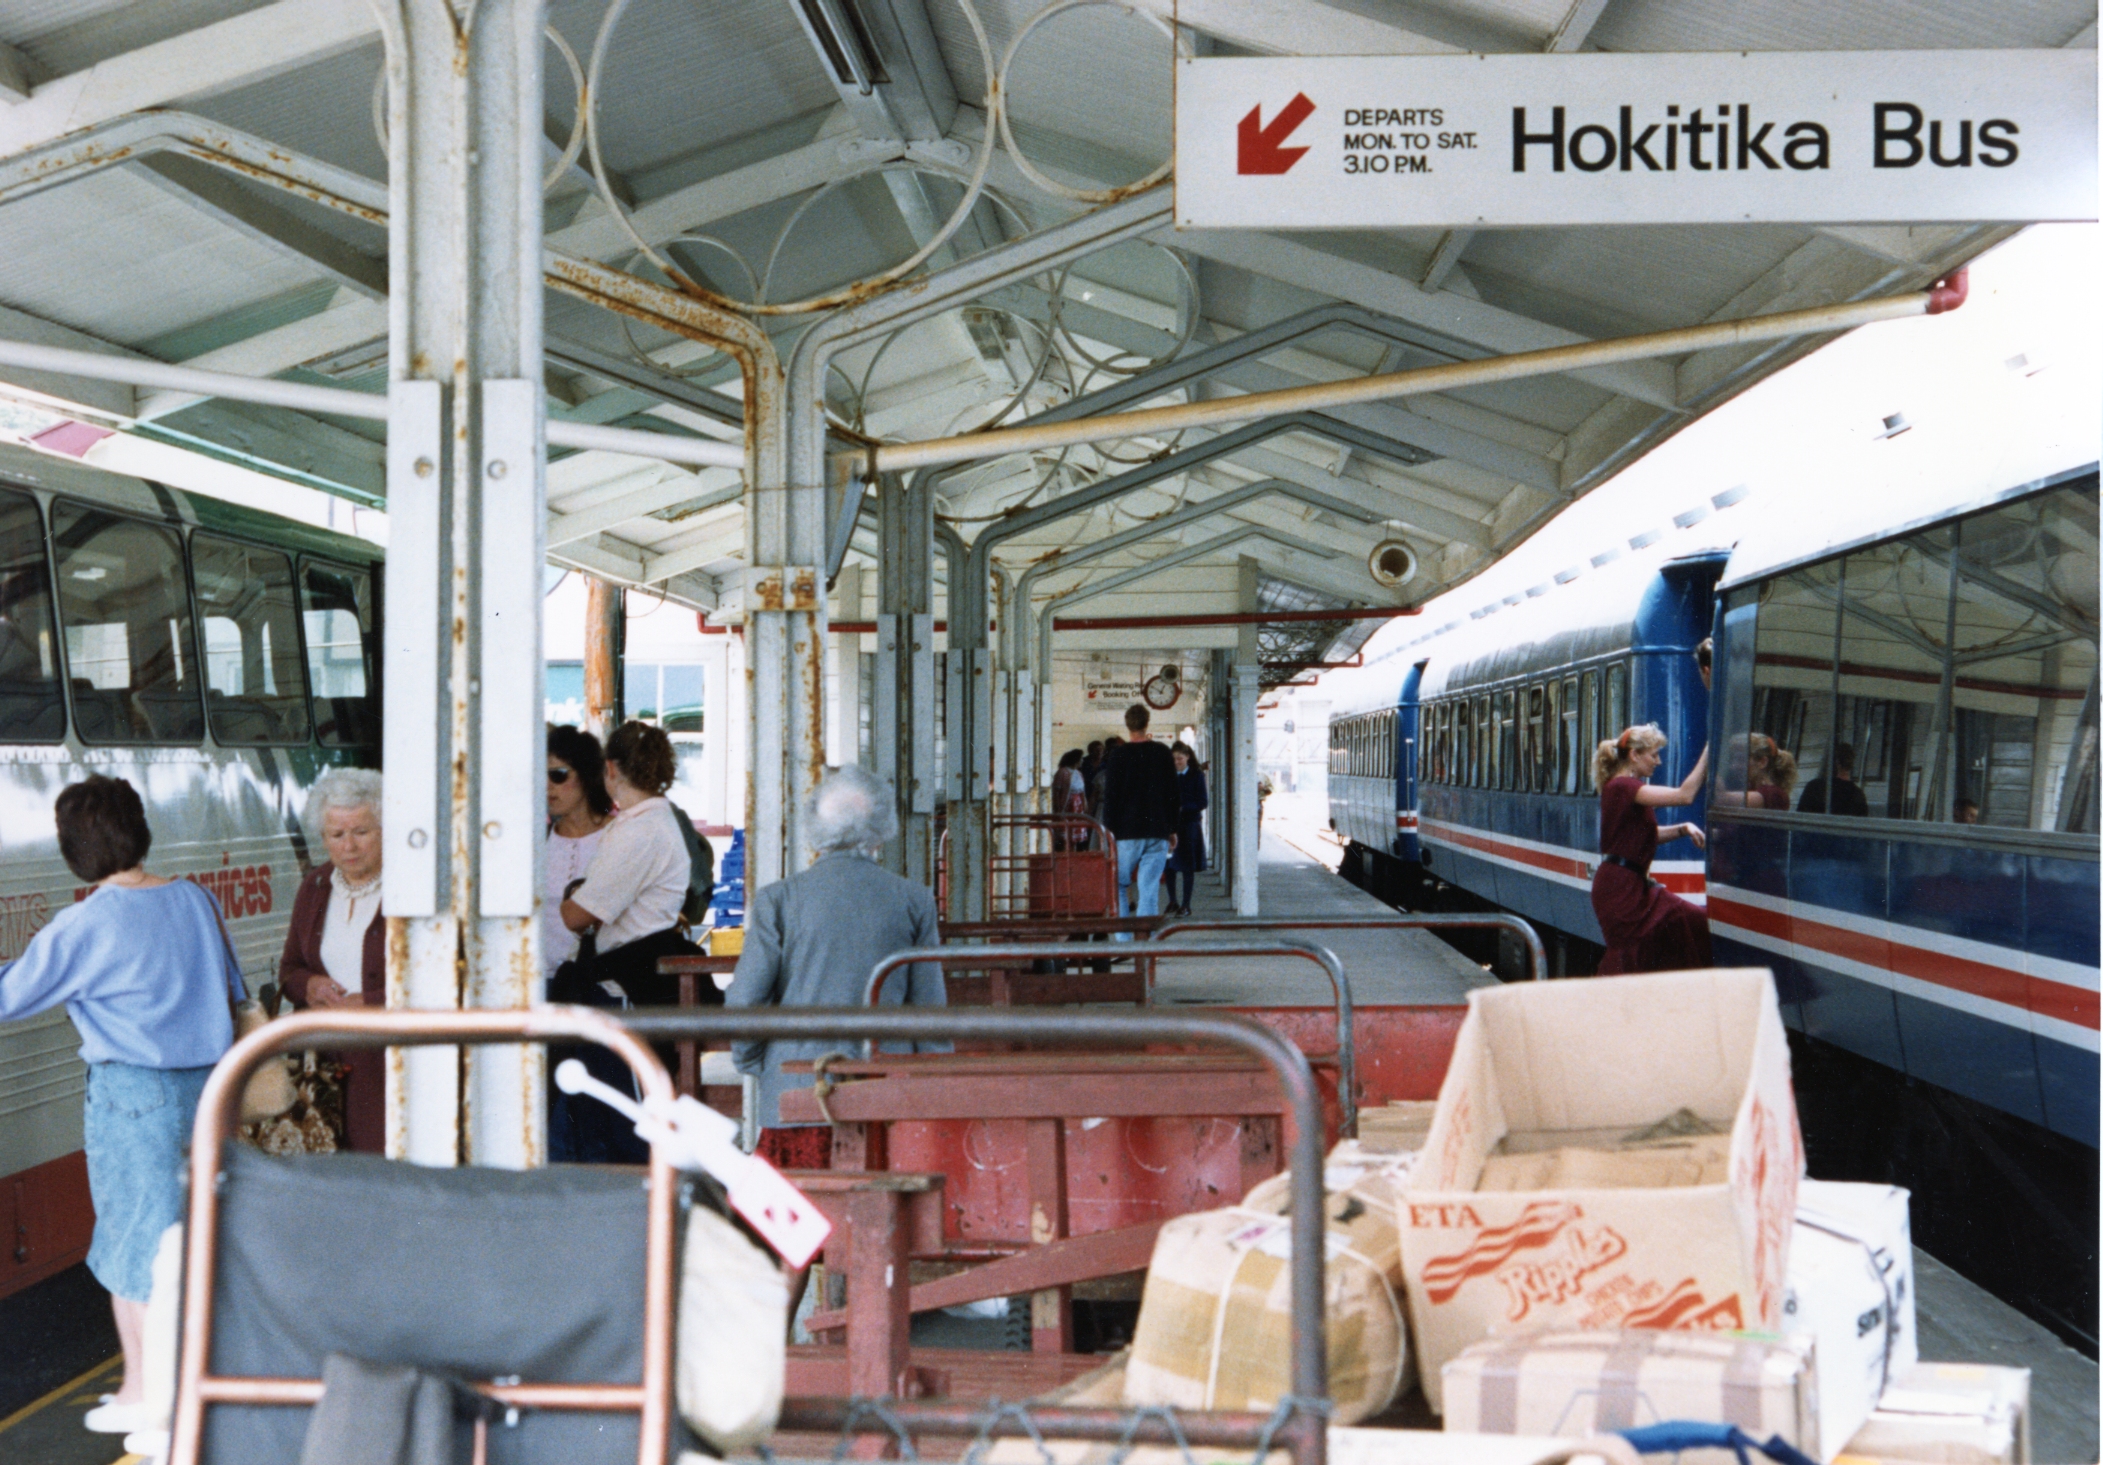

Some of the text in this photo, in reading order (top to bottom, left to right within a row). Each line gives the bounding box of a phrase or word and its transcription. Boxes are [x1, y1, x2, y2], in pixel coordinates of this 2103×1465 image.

[1344, 108, 1444, 126] DEPARTS
[1344, 132, 1478, 150] MON. TO SAT.
[1512, 101, 2020, 172] Hokitika Bus
[1343, 154, 1390, 174] 3.10
[1408, 1203, 1484, 1228] ETA
